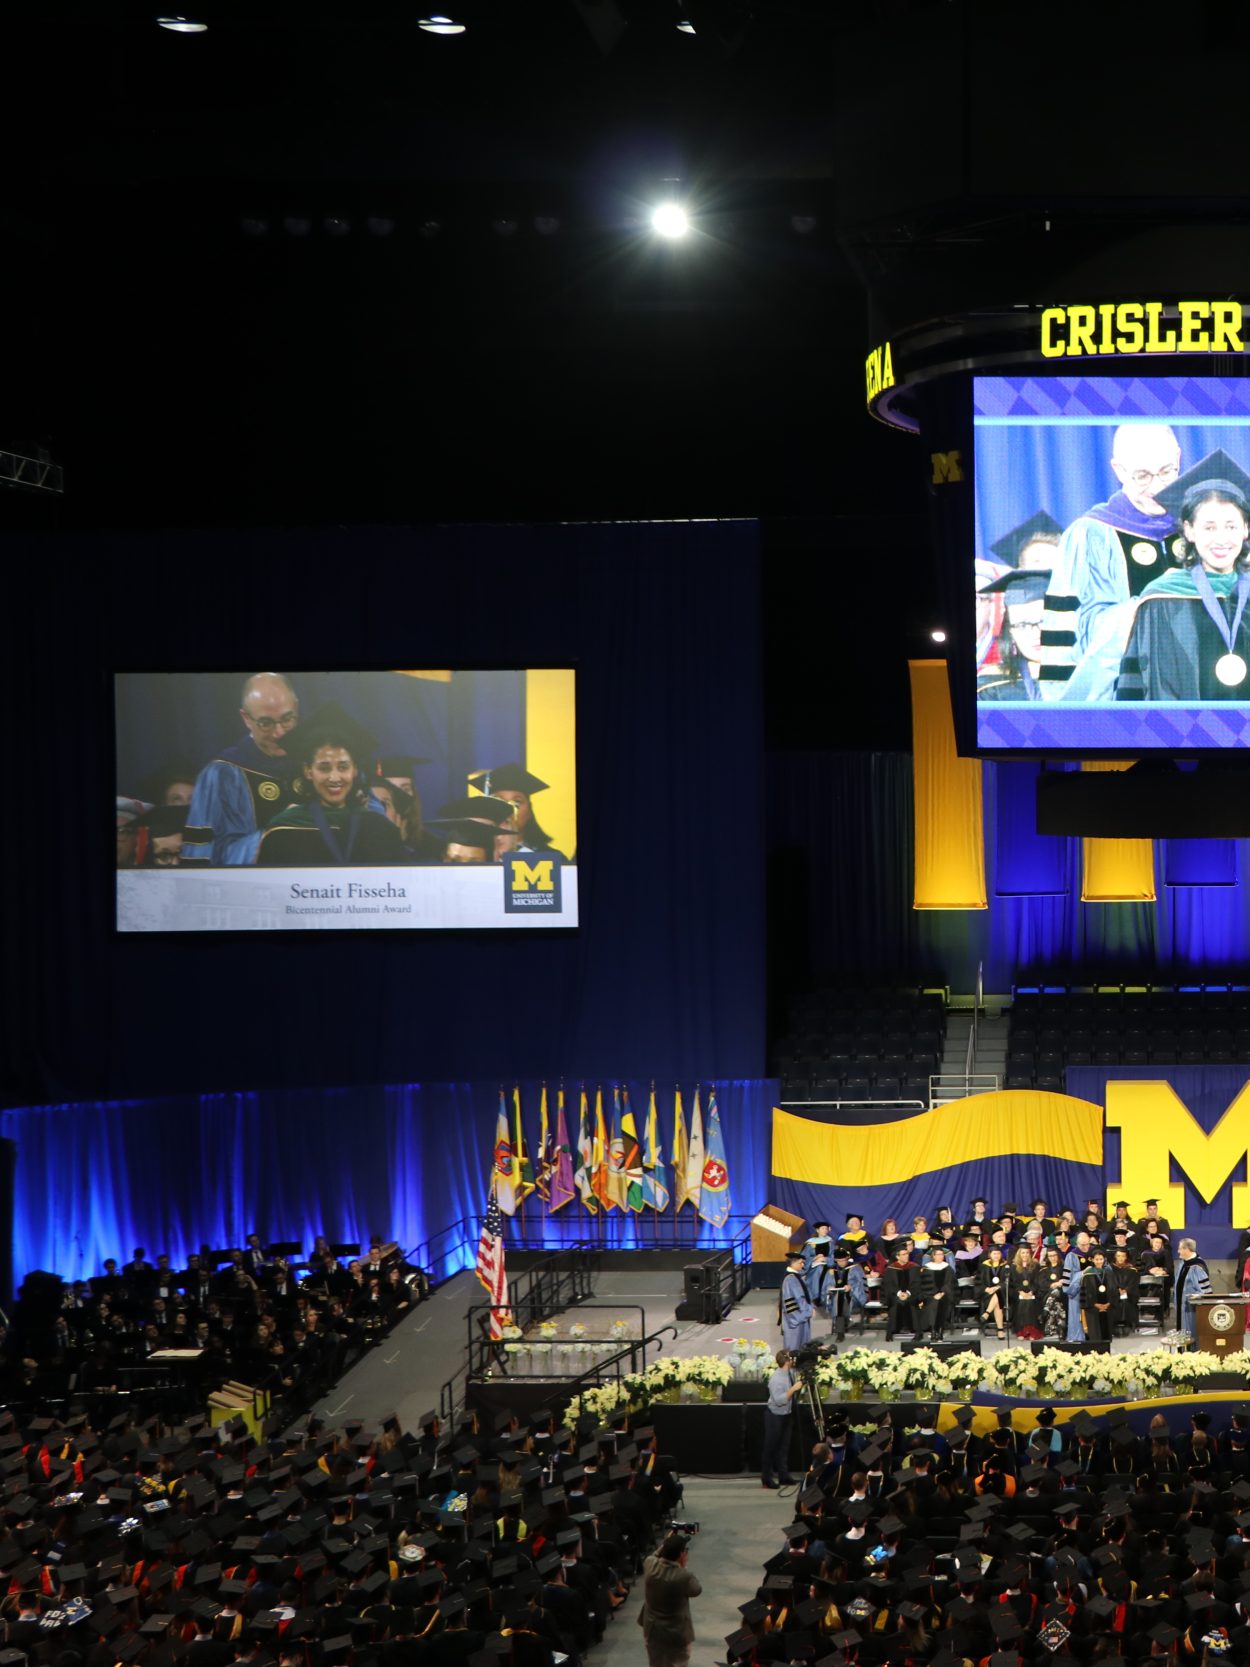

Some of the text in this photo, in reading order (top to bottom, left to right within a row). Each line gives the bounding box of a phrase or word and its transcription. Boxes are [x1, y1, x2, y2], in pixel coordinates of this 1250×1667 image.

[1041, 301, 1244, 358] CRISLER
[931, 450, 961, 484] M
[290, 882, 407, 898] Senait Fisseha
[511, 860, 554, 890] M
[285, 904, 412, 914] Bicentennial Alumni Award
